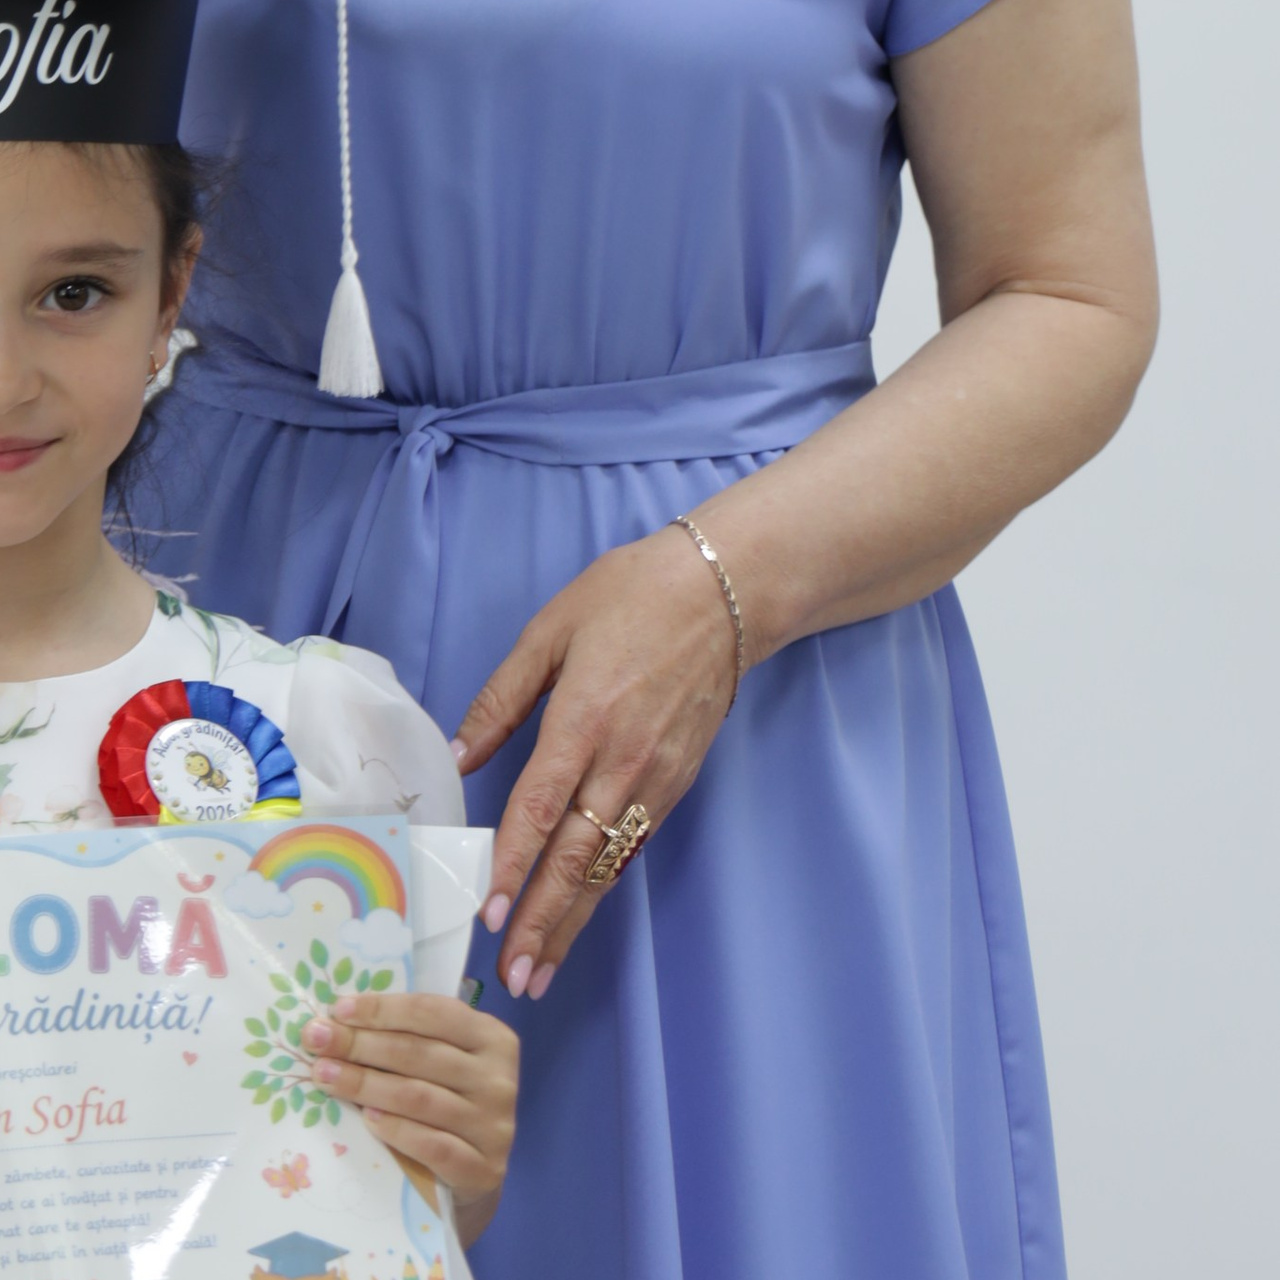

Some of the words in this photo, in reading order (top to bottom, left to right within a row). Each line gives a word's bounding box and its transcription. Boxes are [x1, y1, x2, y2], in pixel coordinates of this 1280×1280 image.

[195, 803, 236, 822] 2026
[25, 1085, 128, 1143] Sofia
[5, 1166, 71, 1184] zâmbete,
[77, 1160, 151, 1177] curiozitate
[156, 1160, 167, 1174] și
[20, 1198, 35, 1209] ce
[42, 1195, 55, 1207] ai
[61, 1190, 112, 1206] învățat
[118, 1189, 128, 1203] și
[135, 1187, 179, 1202] pentru
[28, 1223, 58, 1236] care
[66, 1219, 80, 1232] te
[86, 1213, 151, 1235] așteaptă!
[0, 1253, 10, 1269] și
[17, 1246, 66, 1264] bucurii
[72, 1244, 87, 1258] în
[93, 1242, 130, 1259] viață
